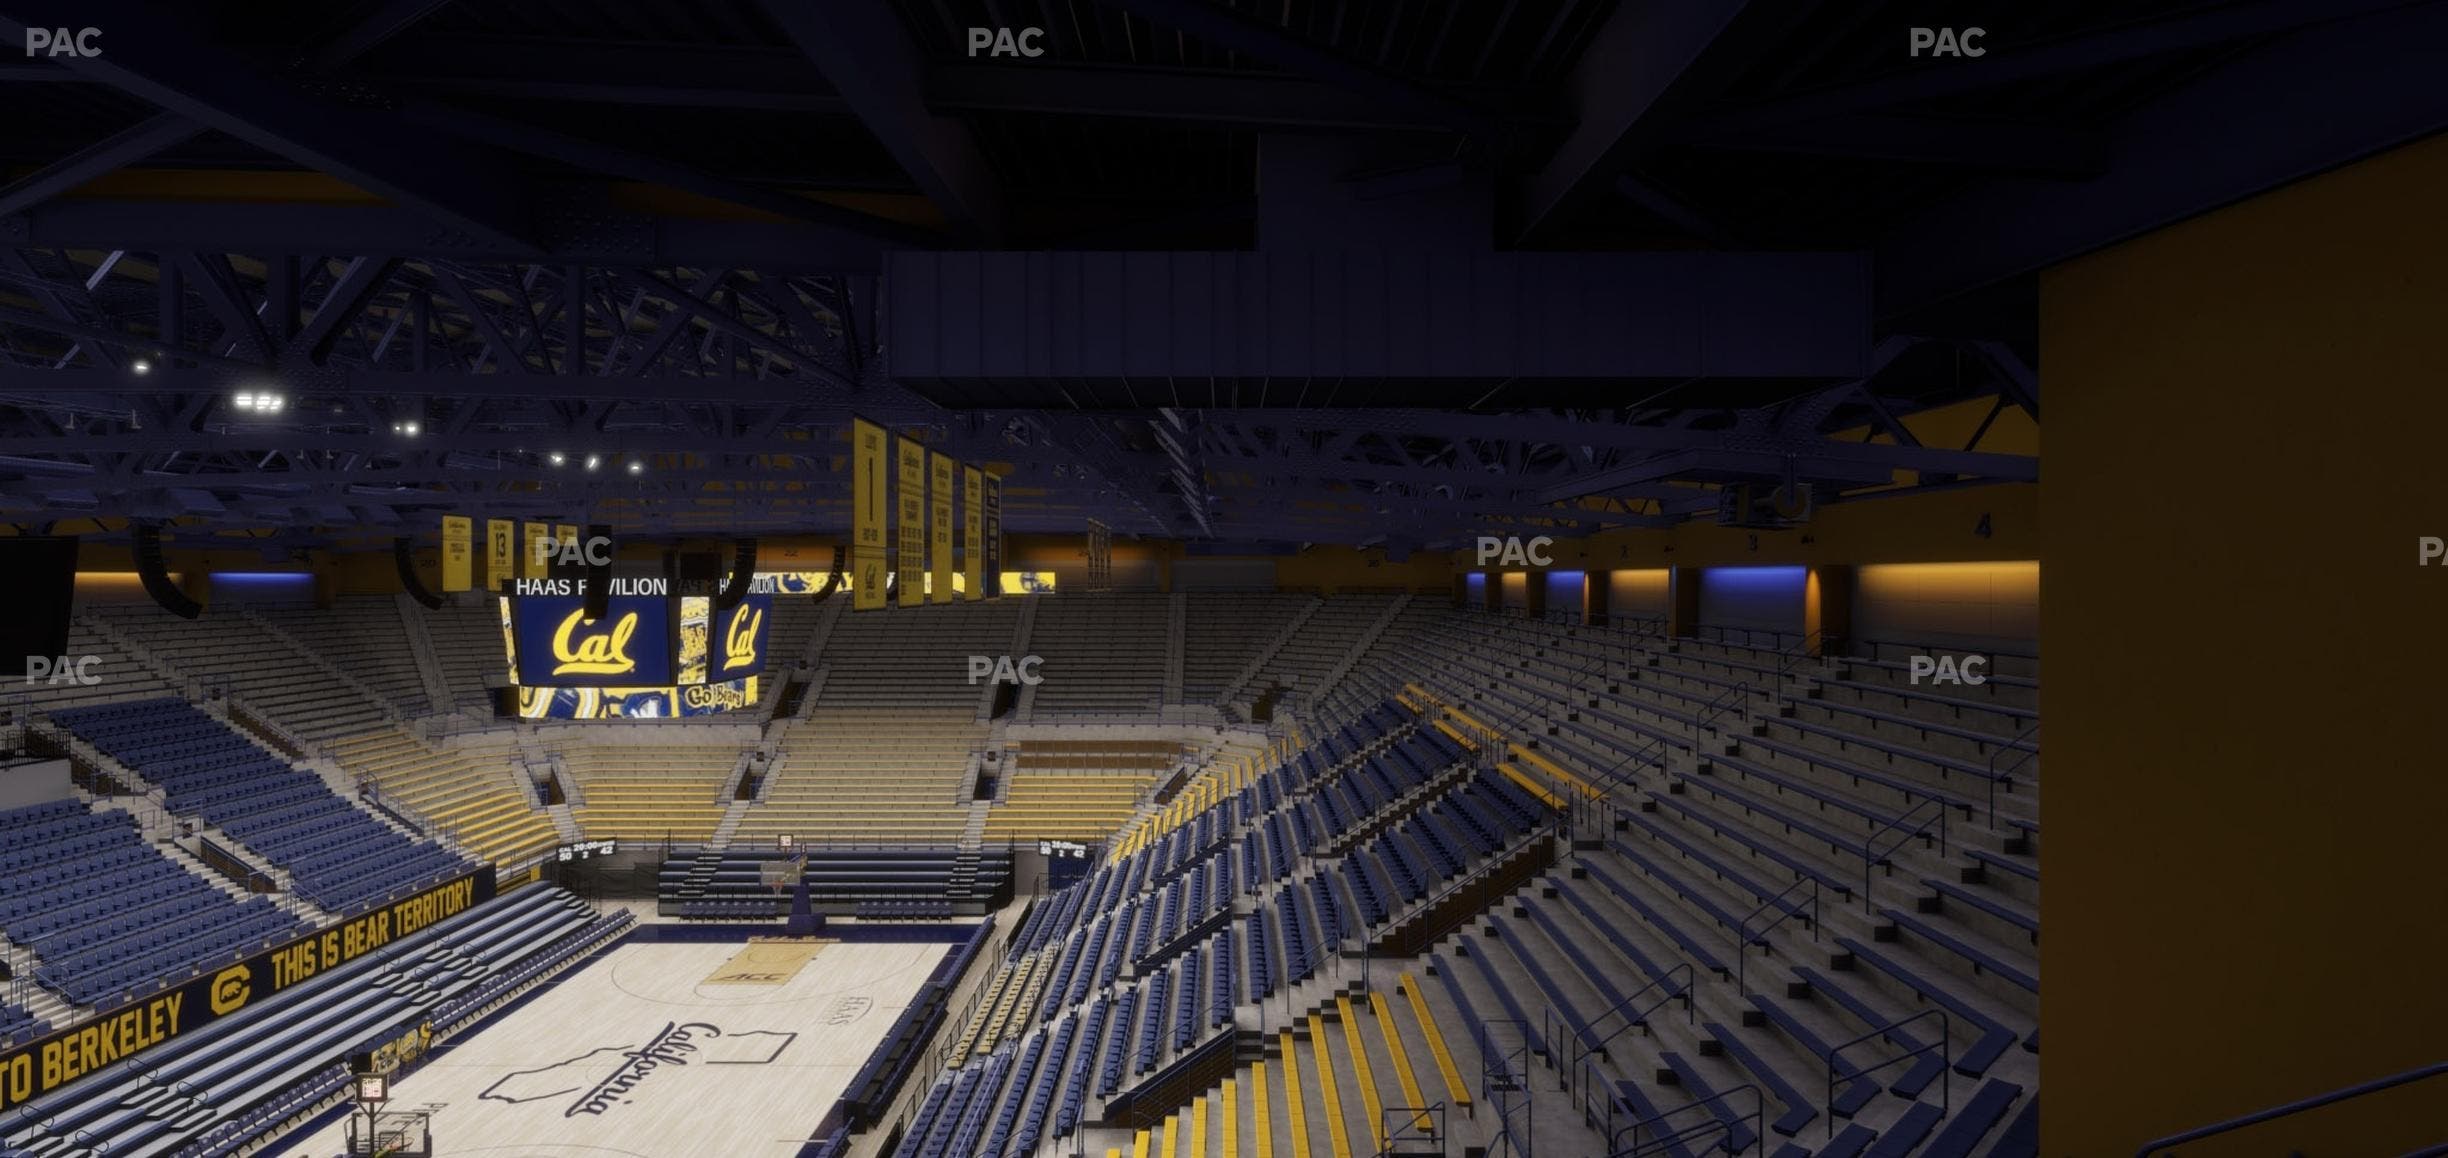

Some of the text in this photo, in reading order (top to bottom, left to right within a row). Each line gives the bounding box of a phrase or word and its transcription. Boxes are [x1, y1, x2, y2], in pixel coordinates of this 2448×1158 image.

[516, 578, 571, 596] HAAS
[552, 607, 638, 676] Cal
[723, 603, 762, 671] Cal
[687, 685, 712, 705] Go
[559, 852, 572, 861] 50
[600, 846, 613, 854] 42
[42, 991, 183, 1091] BERKELEY
[271, 940, 316, 990] THIS
[321, 930, 339, 970] IS
[343, 911, 390, 960] BEAR
[394, 877, 474, 937] TERRITORY
[565, 1021, 721, 1118] California
